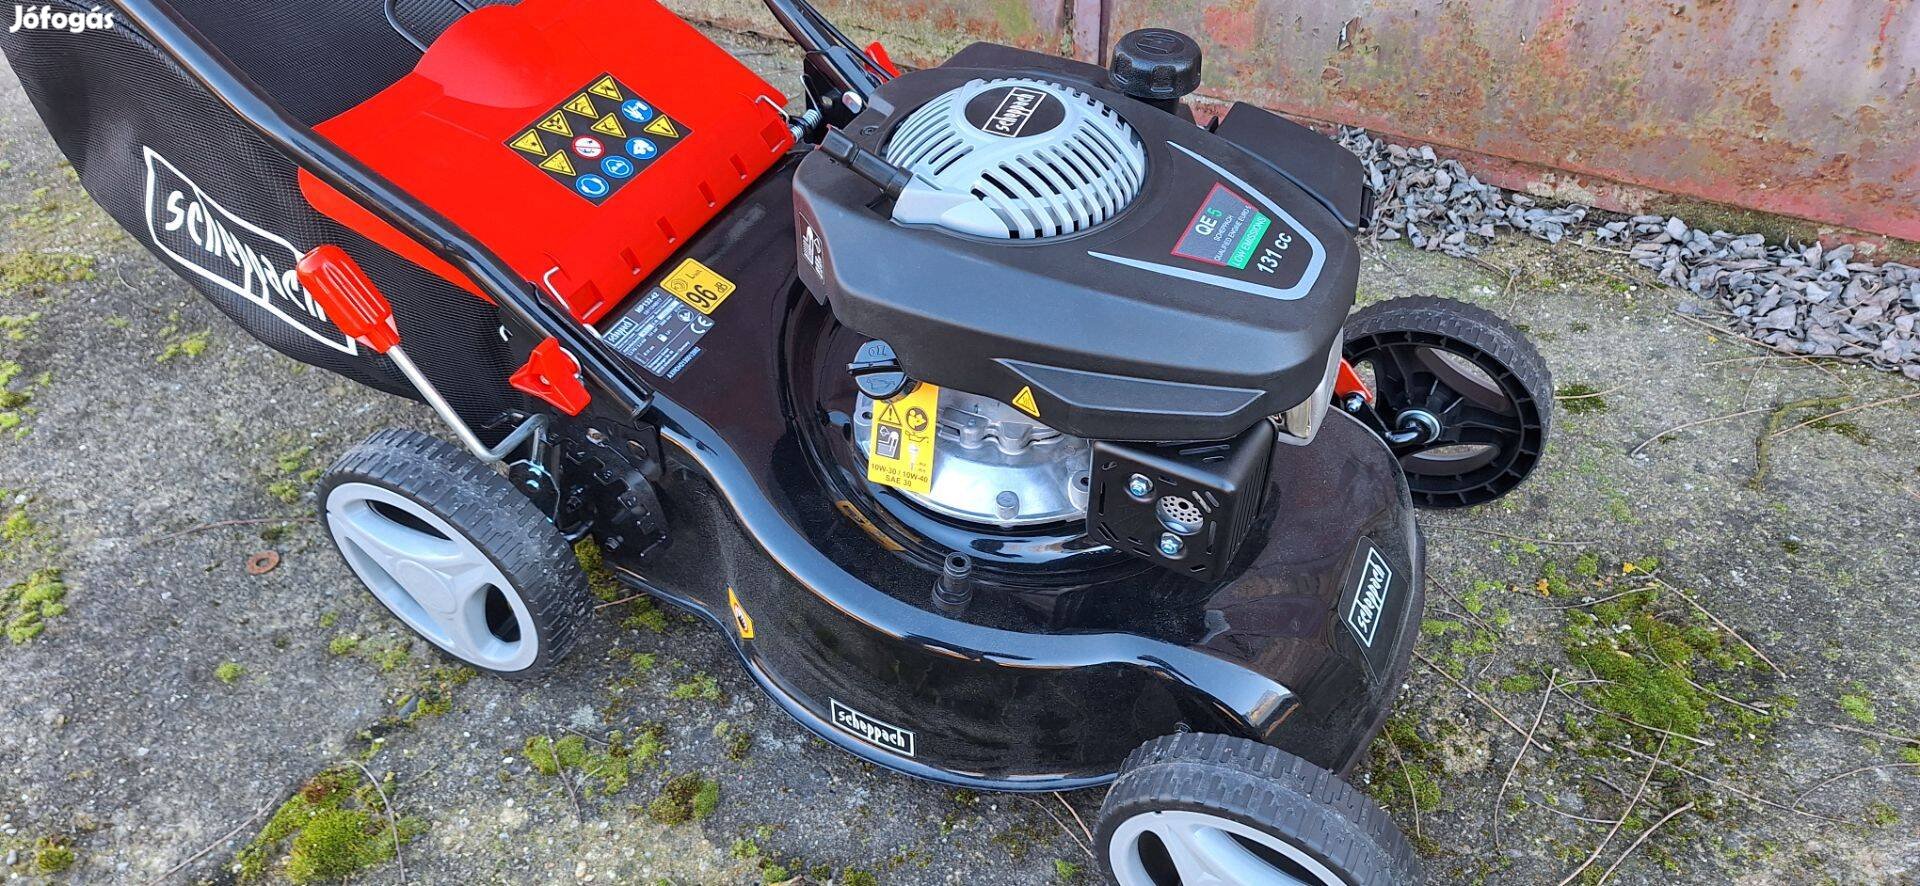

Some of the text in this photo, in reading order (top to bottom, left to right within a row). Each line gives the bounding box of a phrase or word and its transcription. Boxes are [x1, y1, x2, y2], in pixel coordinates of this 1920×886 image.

[994, 93, 1036, 132] scheppach
[1195, 207, 1222, 236] QE 5
[1214, 214, 1233, 241] SCHEPPACH
[1214, 236, 1233, 261] QUALIFIED
[1234, 217, 1267, 268] LOW EMISSIONS
[1256, 232, 1292, 274] 131 cc
[686, 284, 718, 308] 96
[871, 463, 897, 475] 10W-30
[902, 471, 929, 483] 10W-40
[885, 474, 912, 487] SAE 30
[1357, 561, 1385, 633] scheppach
[838, 710, 905, 748] scheppach
